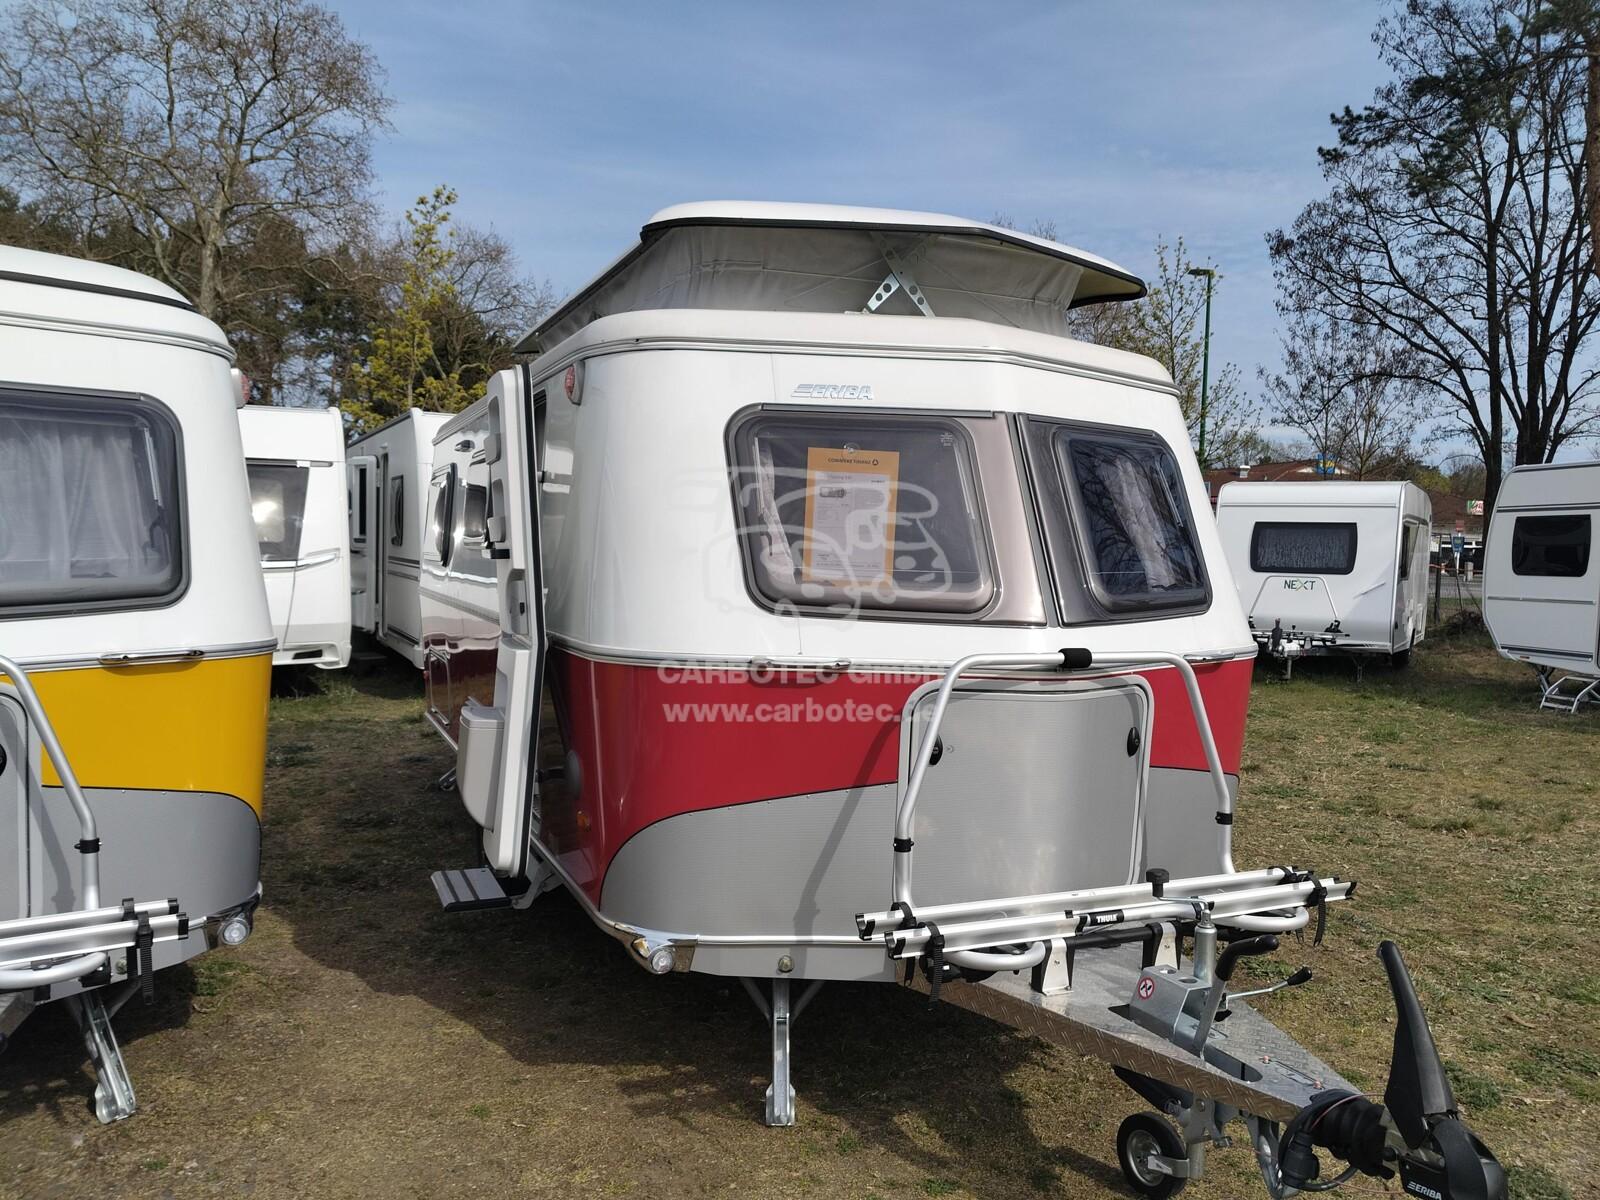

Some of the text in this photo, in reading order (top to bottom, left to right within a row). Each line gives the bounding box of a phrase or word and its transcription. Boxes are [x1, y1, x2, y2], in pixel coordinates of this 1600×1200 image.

[810, 384, 874, 400] ERIBA
[1284, 579, 1316, 591] NEXT
[1414, 1183, 1442, 1200] ERIBA
